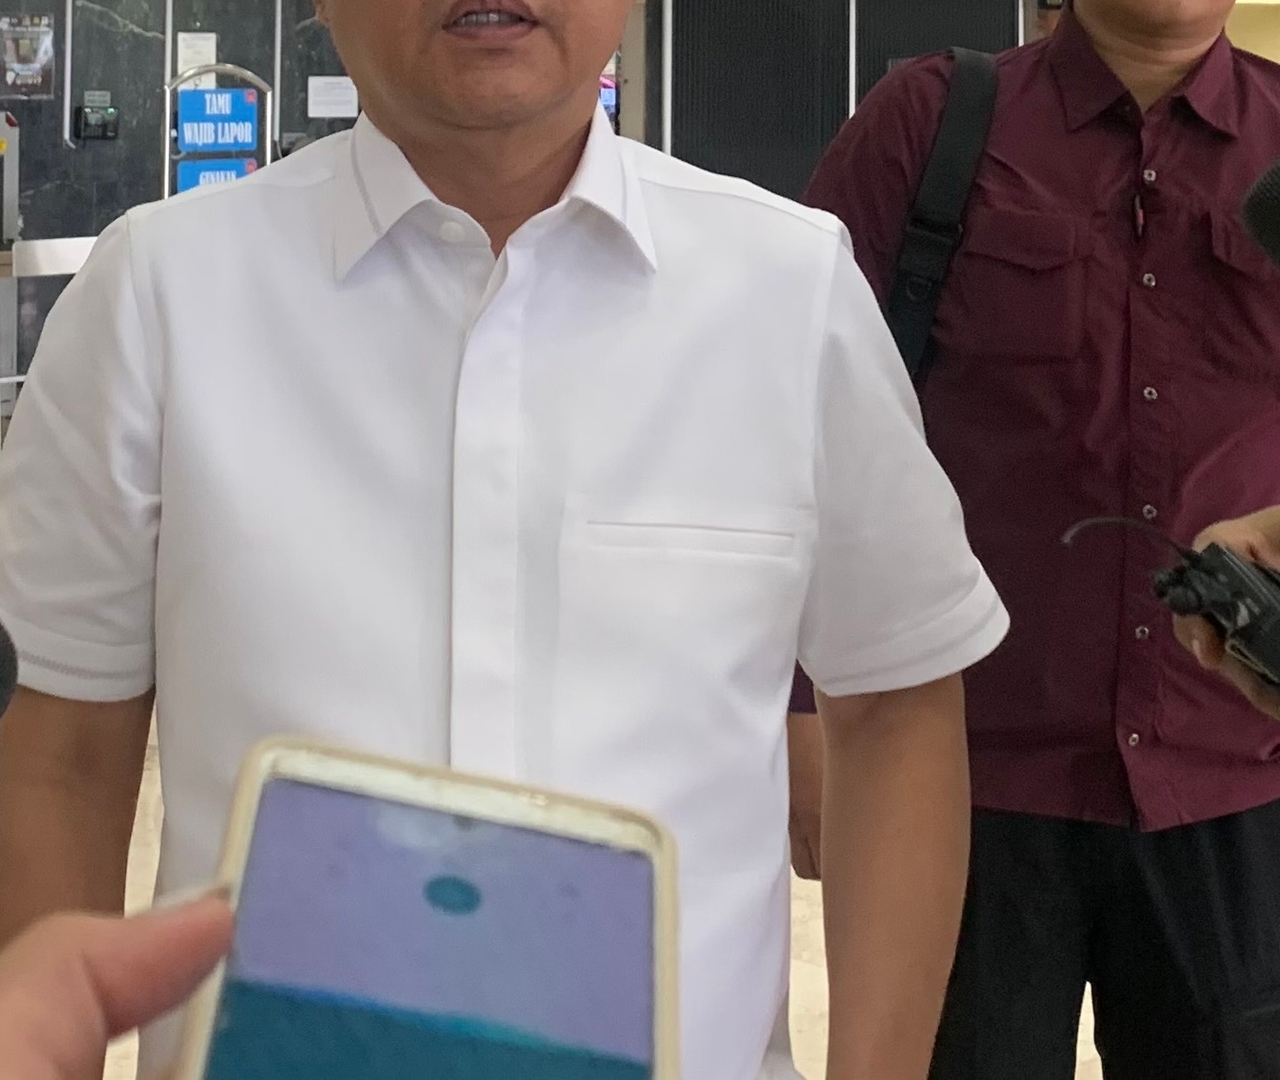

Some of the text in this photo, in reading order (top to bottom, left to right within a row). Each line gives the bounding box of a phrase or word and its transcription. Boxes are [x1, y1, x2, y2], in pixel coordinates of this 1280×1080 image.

[204, 92, 232, 116] TAMU
[183, 121, 253, 146] WAJIB LAPOR
